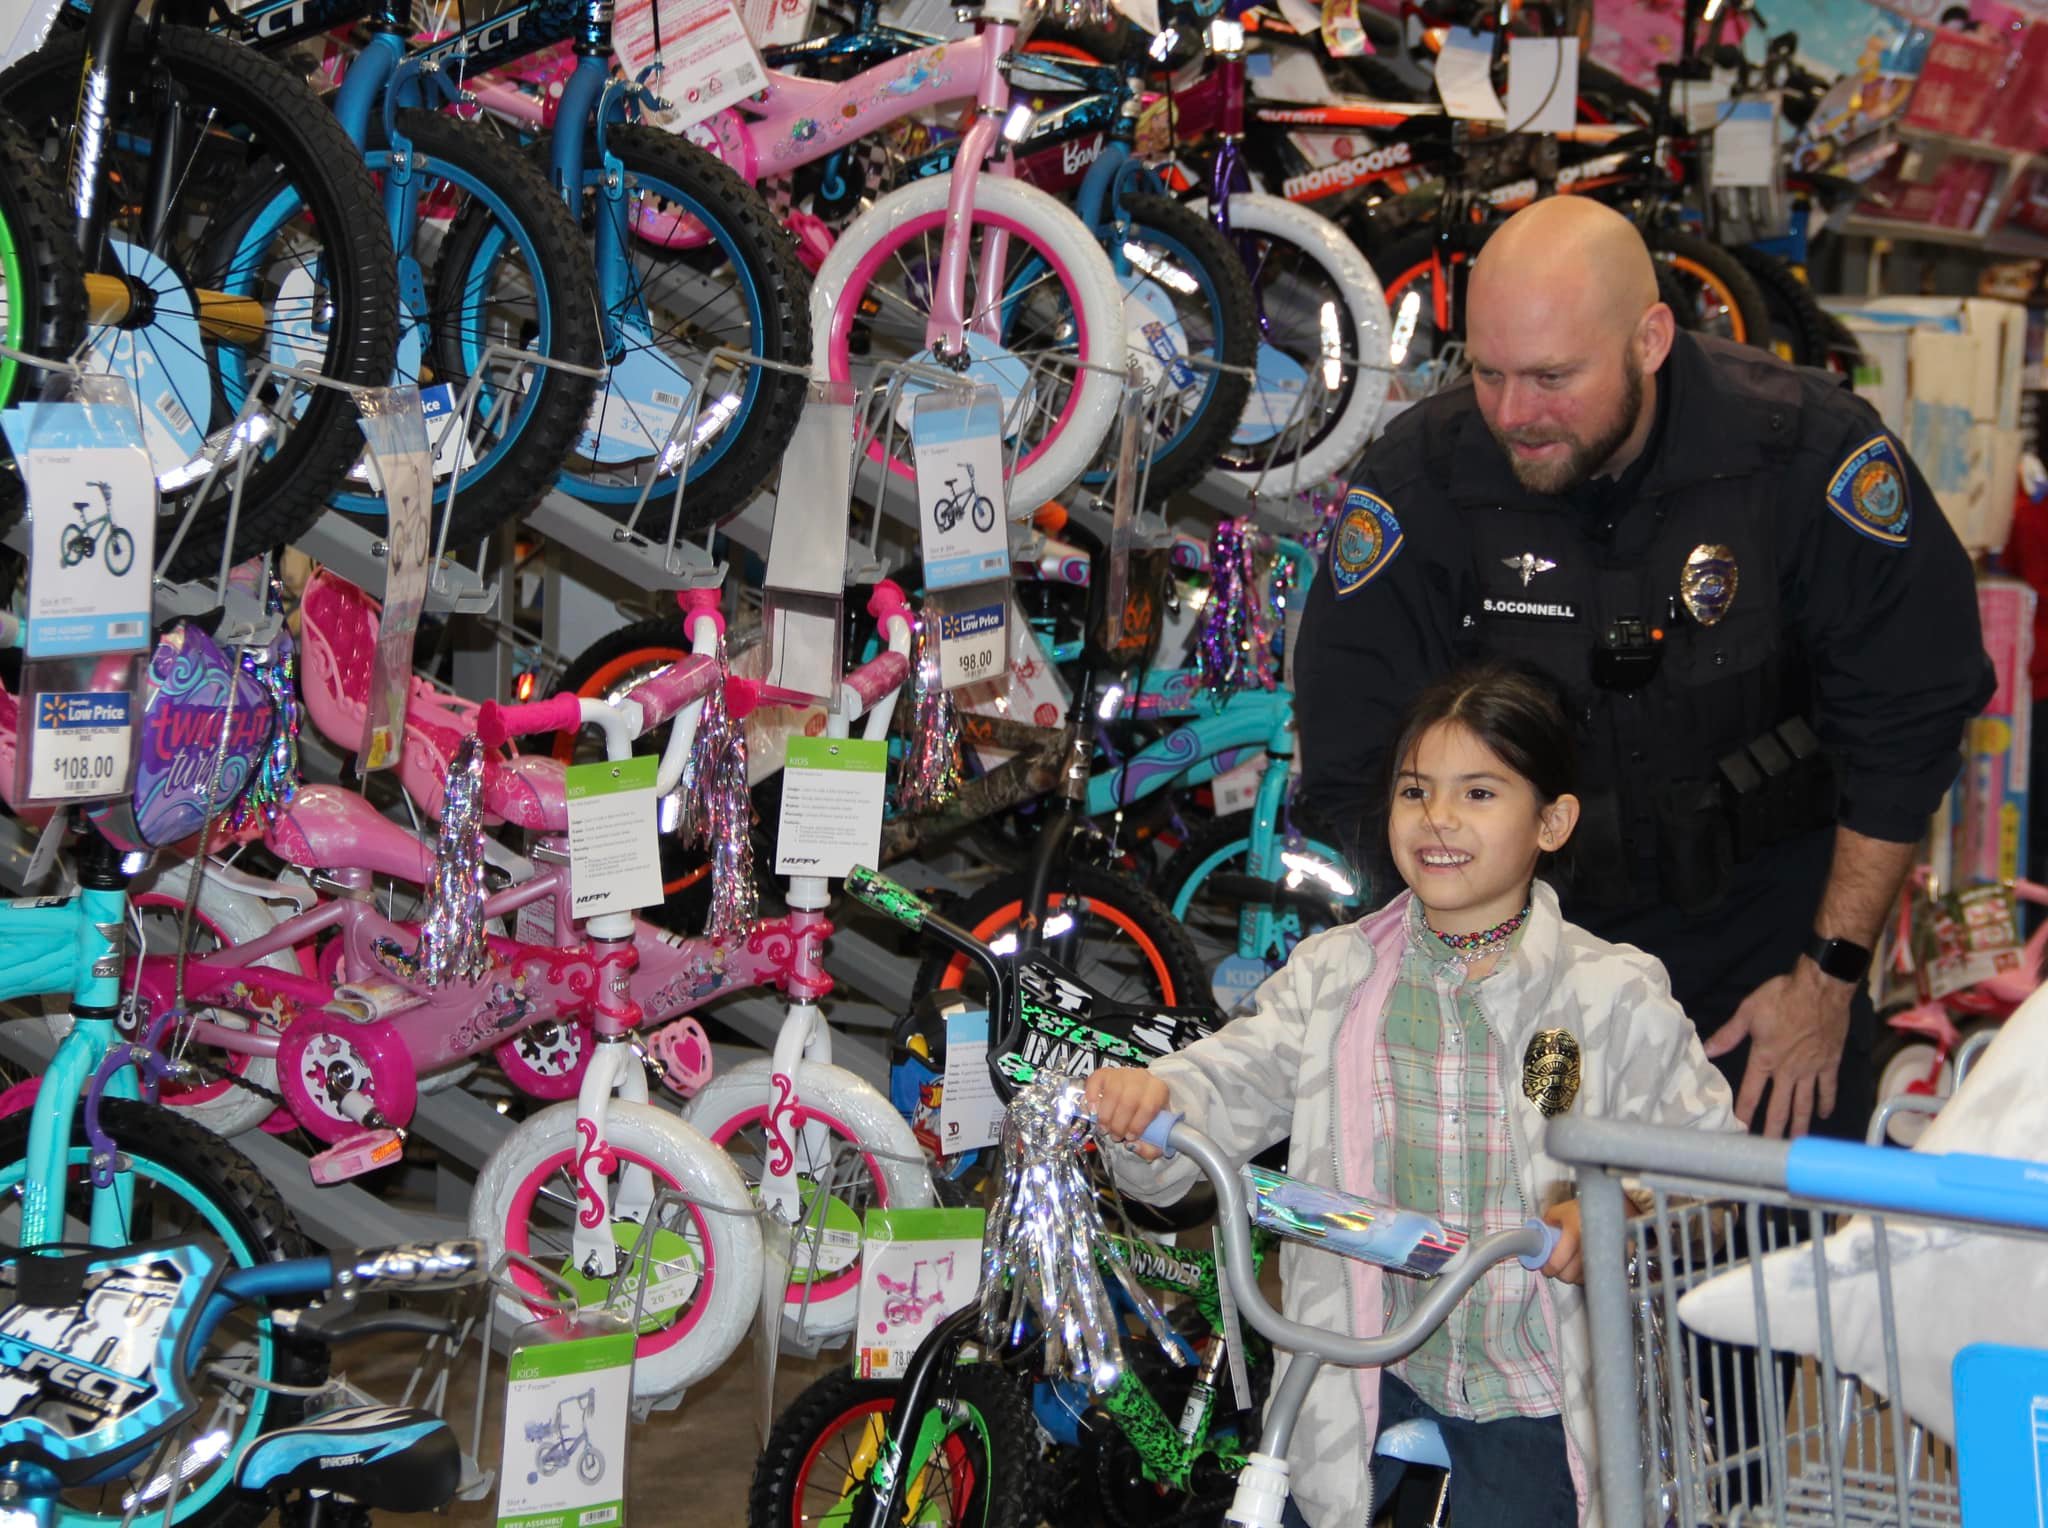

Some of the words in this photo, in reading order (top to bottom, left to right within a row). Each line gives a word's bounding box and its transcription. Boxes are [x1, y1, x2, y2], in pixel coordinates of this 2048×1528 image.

[1283, 142, 1411, 196] mongoose
[1483, 599, 1575, 617] S.OCONNELL
[962, 619, 978, 632] Low
[979, 614, 999, 628] Price
[68, 706, 93, 721] Low
[93, 705, 125, 720] Price
[54, 755, 114, 780] $108.00
[576, 892, 611, 904] HUFFY
